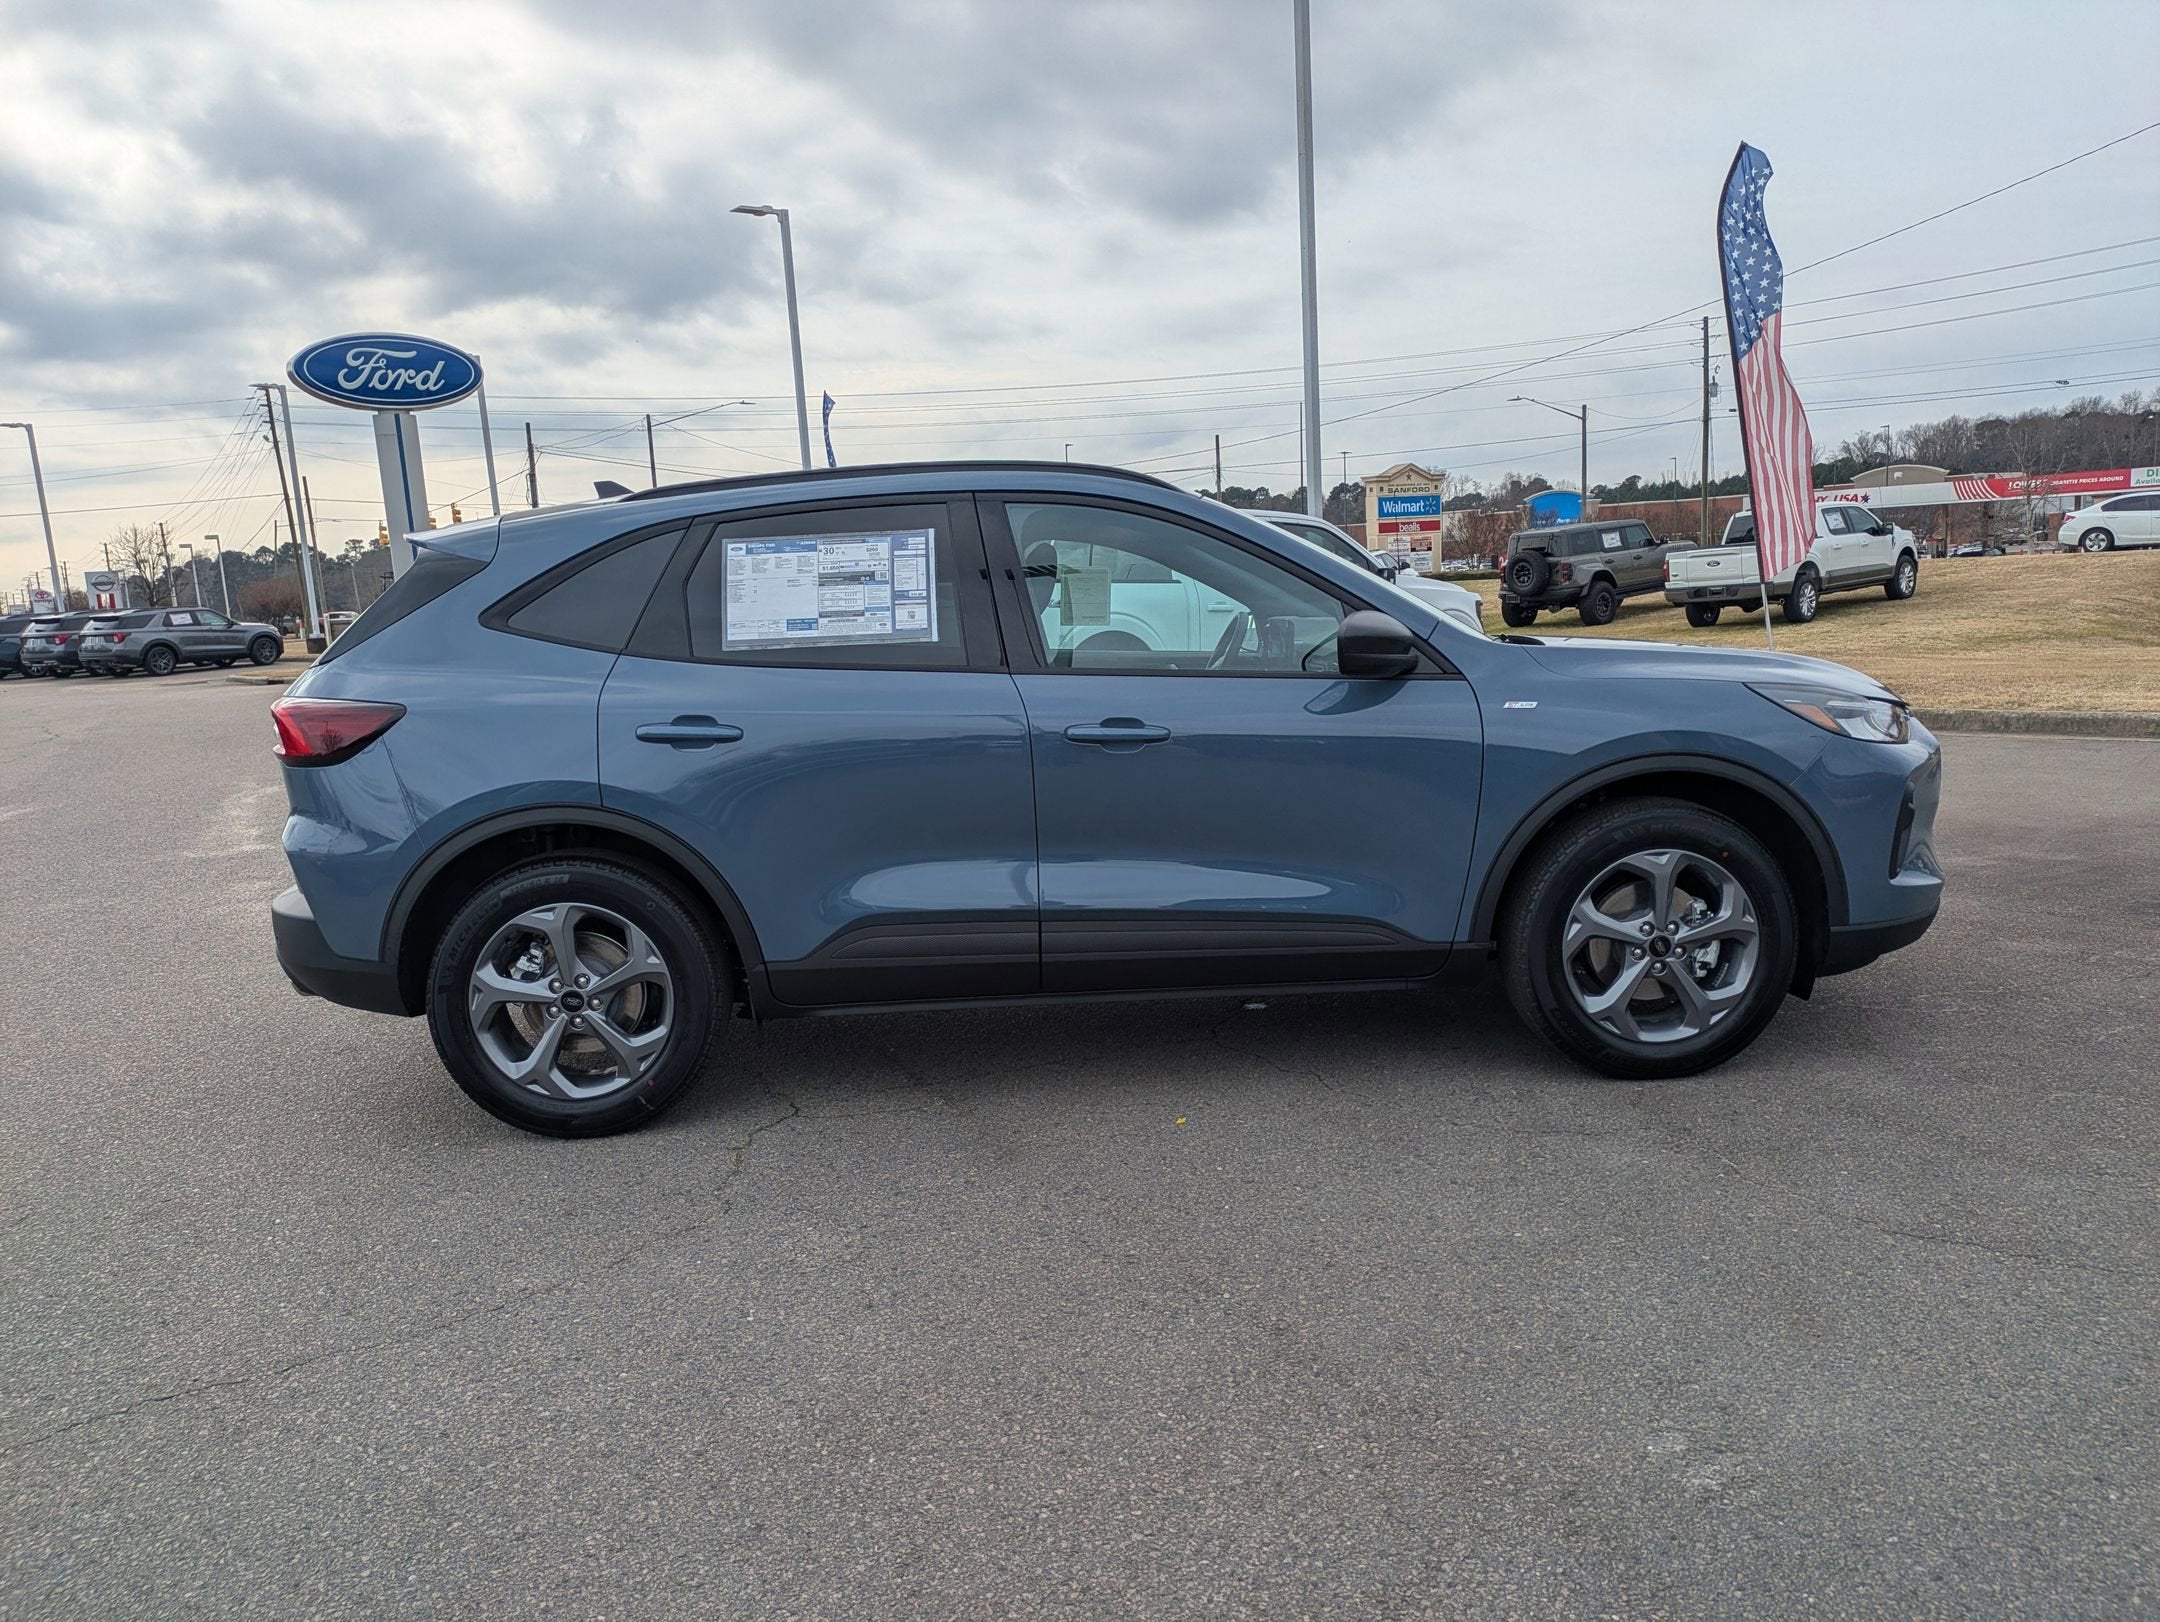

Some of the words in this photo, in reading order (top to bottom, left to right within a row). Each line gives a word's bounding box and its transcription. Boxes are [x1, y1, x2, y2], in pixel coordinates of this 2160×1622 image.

[337, 347, 445, 391] Ford
[2098, 475, 2125, 483] AROUND
[1387, 486, 1431, 494] SANFORD
[1834, 493, 1859, 503] USA
[1382, 499, 1425, 514] Walmart
[1399, 521, 1421, 531] bealls
[823, 546, 835, 555] 30
